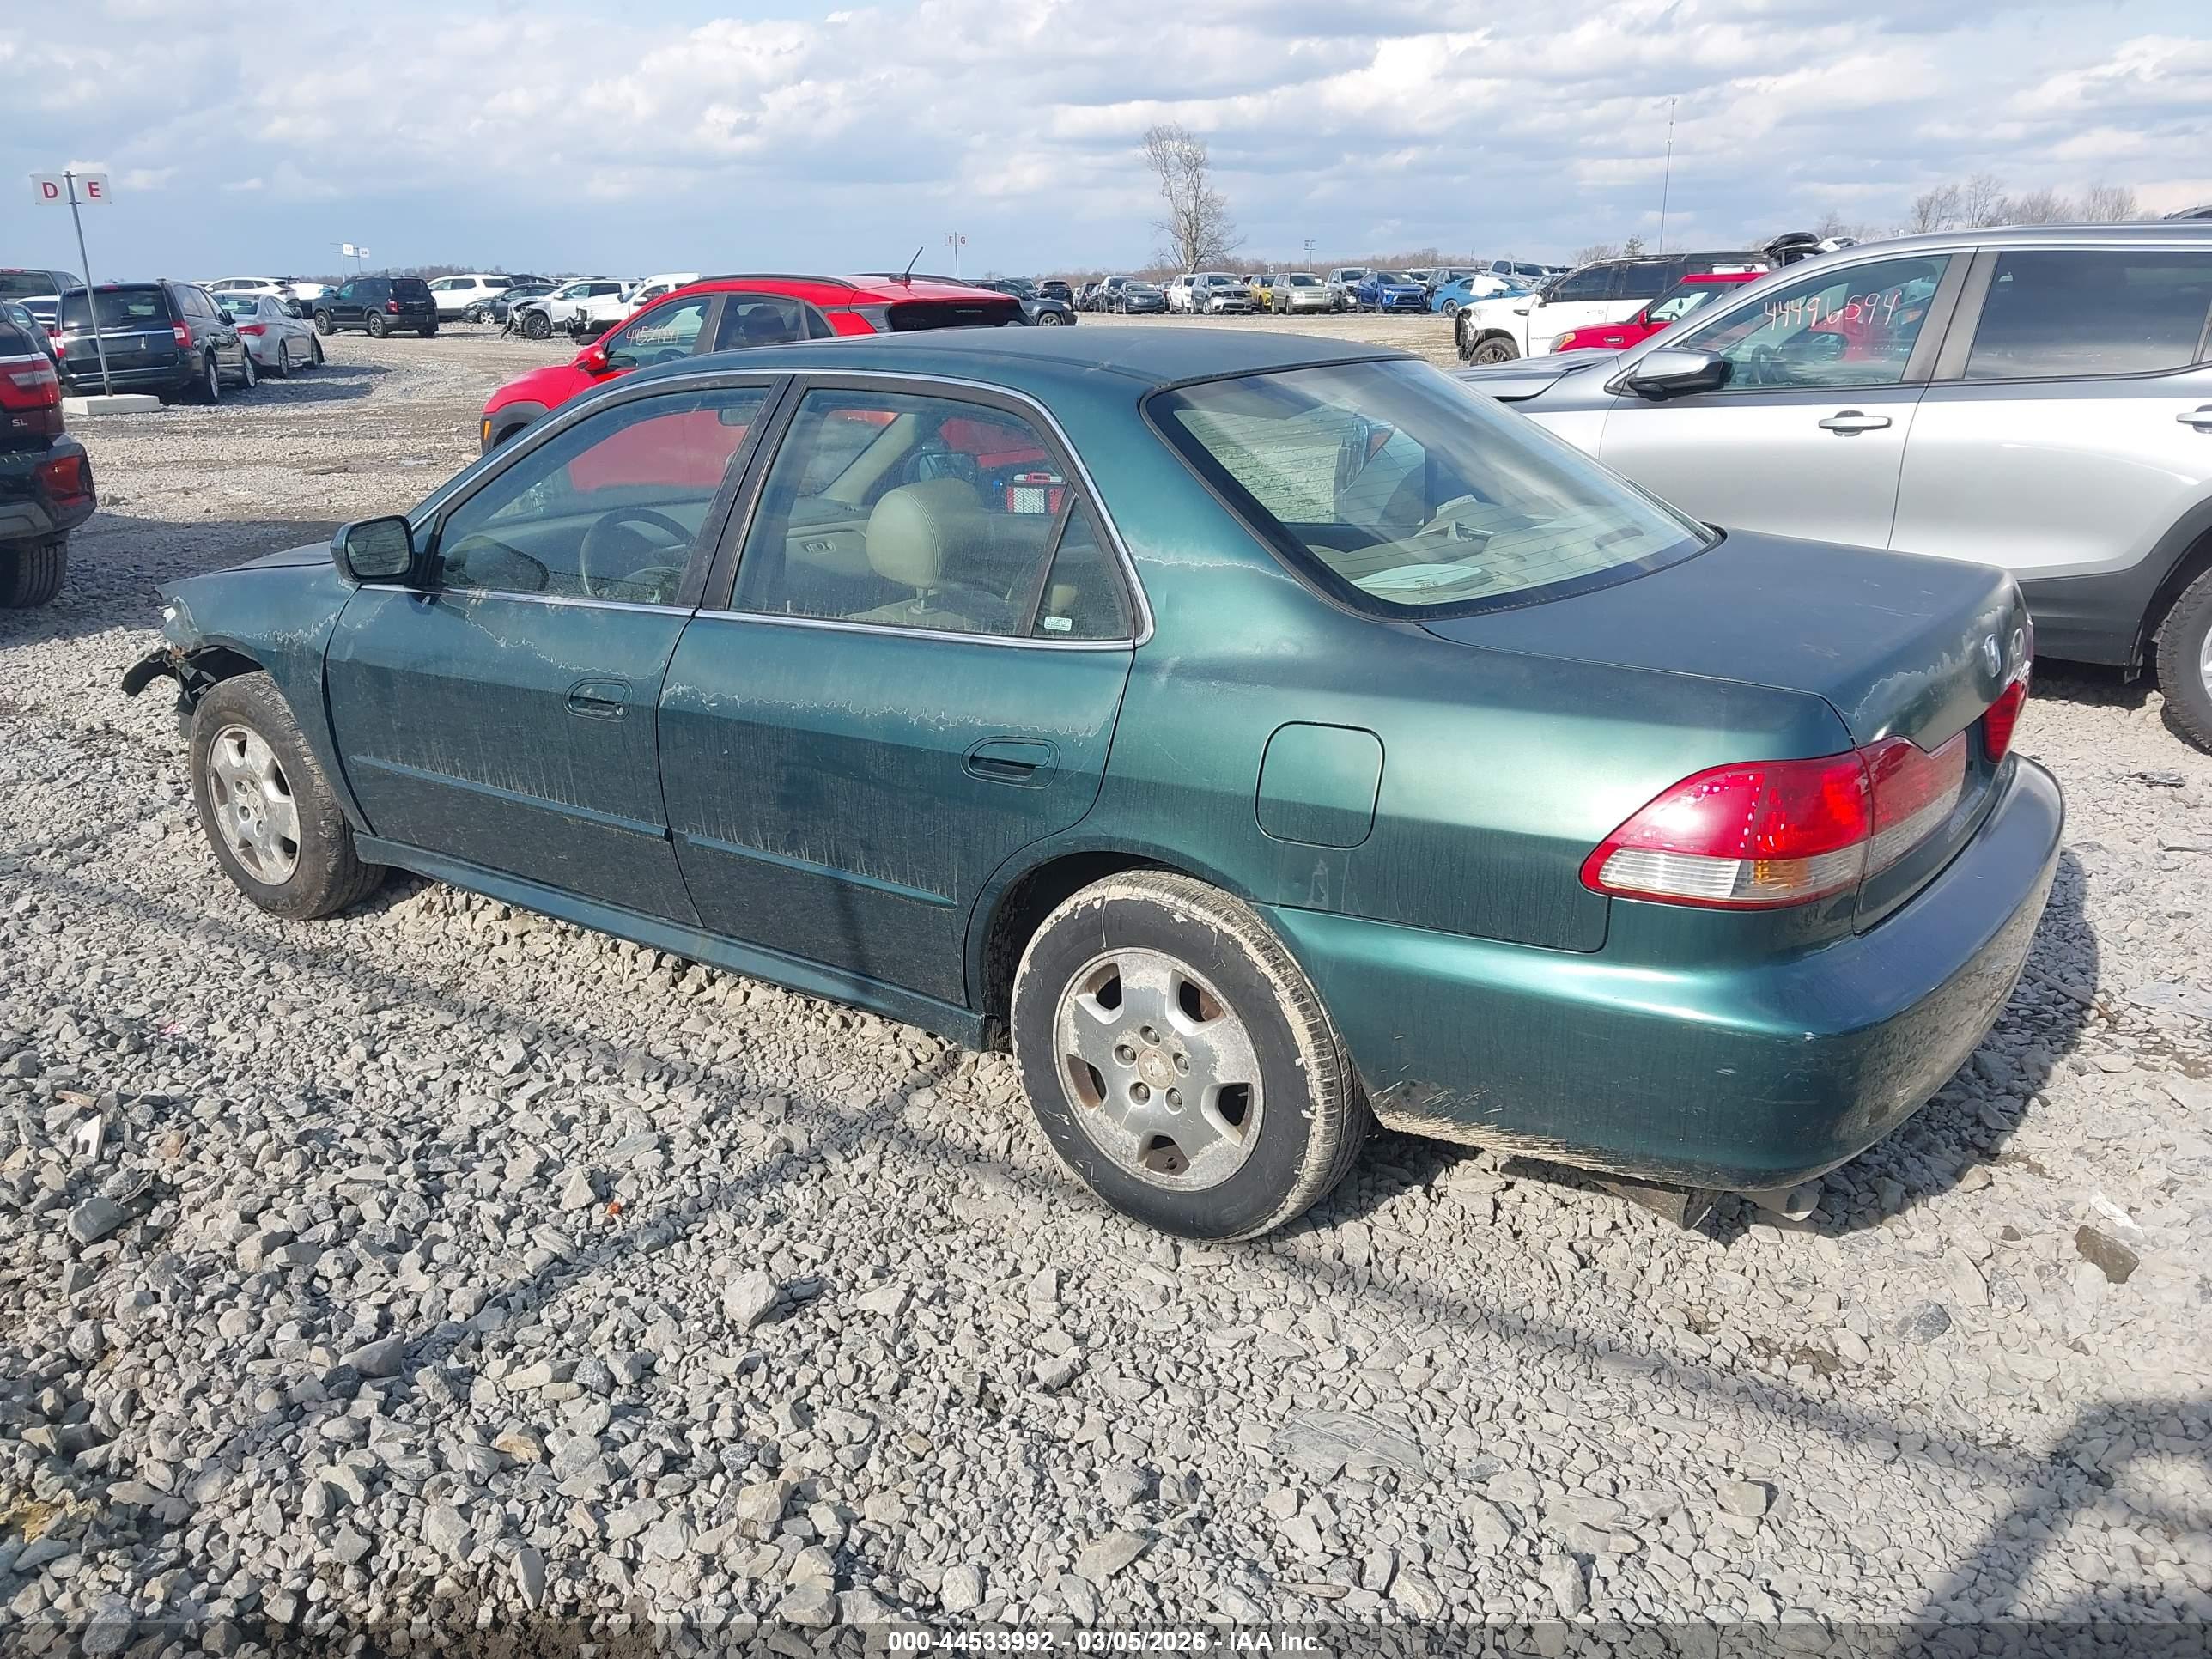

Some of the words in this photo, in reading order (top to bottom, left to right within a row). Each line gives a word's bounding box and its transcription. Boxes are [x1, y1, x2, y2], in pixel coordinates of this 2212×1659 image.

[41, 181, 58, 199] D
[88, 181, 101, 198] E
[948, 235, 954, 244] F
[960, 236, 966, 245] G
[12, 418, 28, 427] SL
